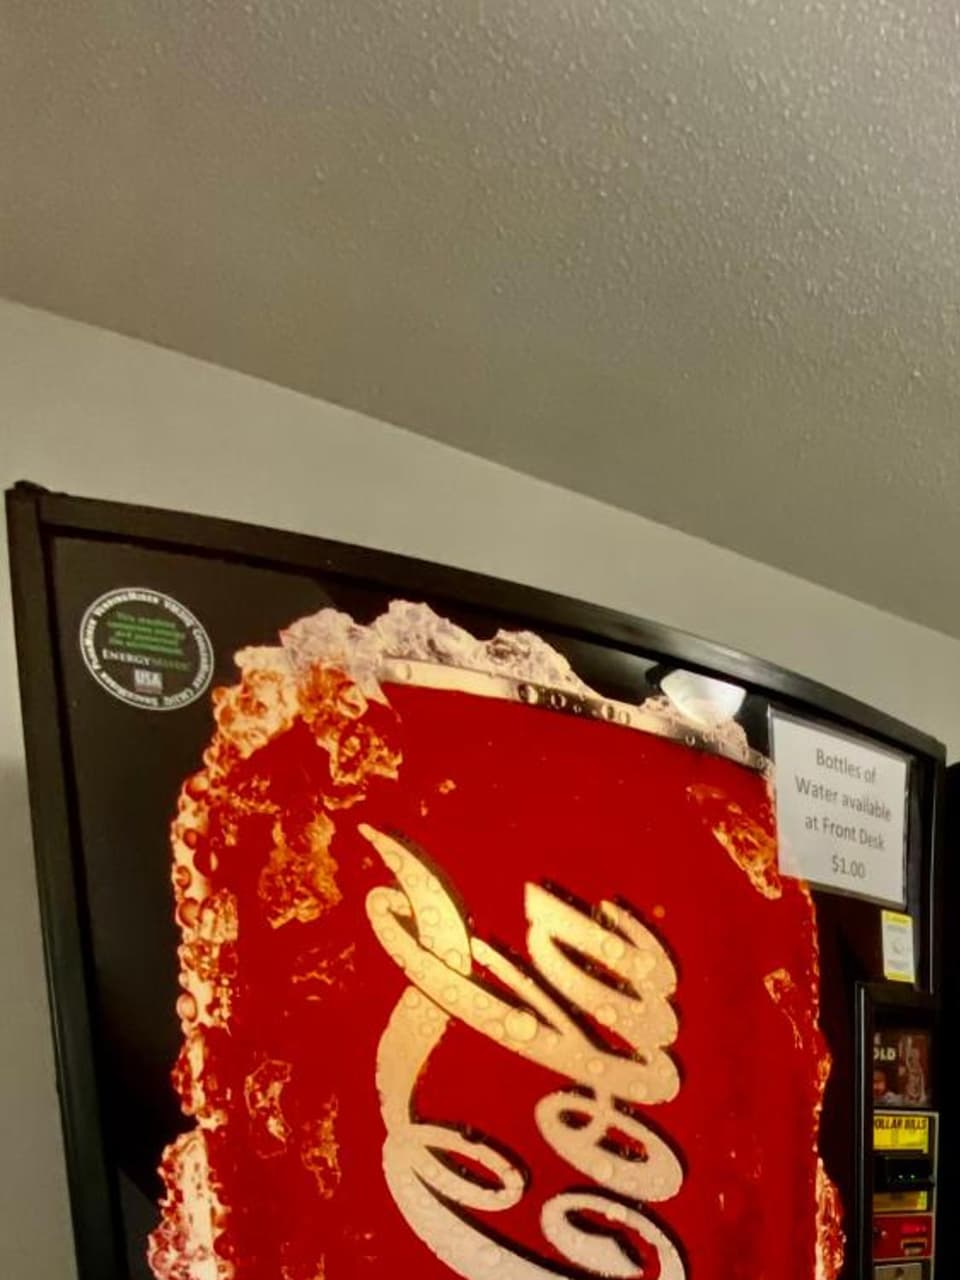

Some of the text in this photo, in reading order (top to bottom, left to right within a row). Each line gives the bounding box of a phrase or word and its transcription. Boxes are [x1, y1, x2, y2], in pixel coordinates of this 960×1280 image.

[816, 748, 877, 784] Bottles of
[794, 775, 892, 822] Water available
[805, 816, 885, 851] at Front Desk
[832, 854, 866, 879] $1.00
